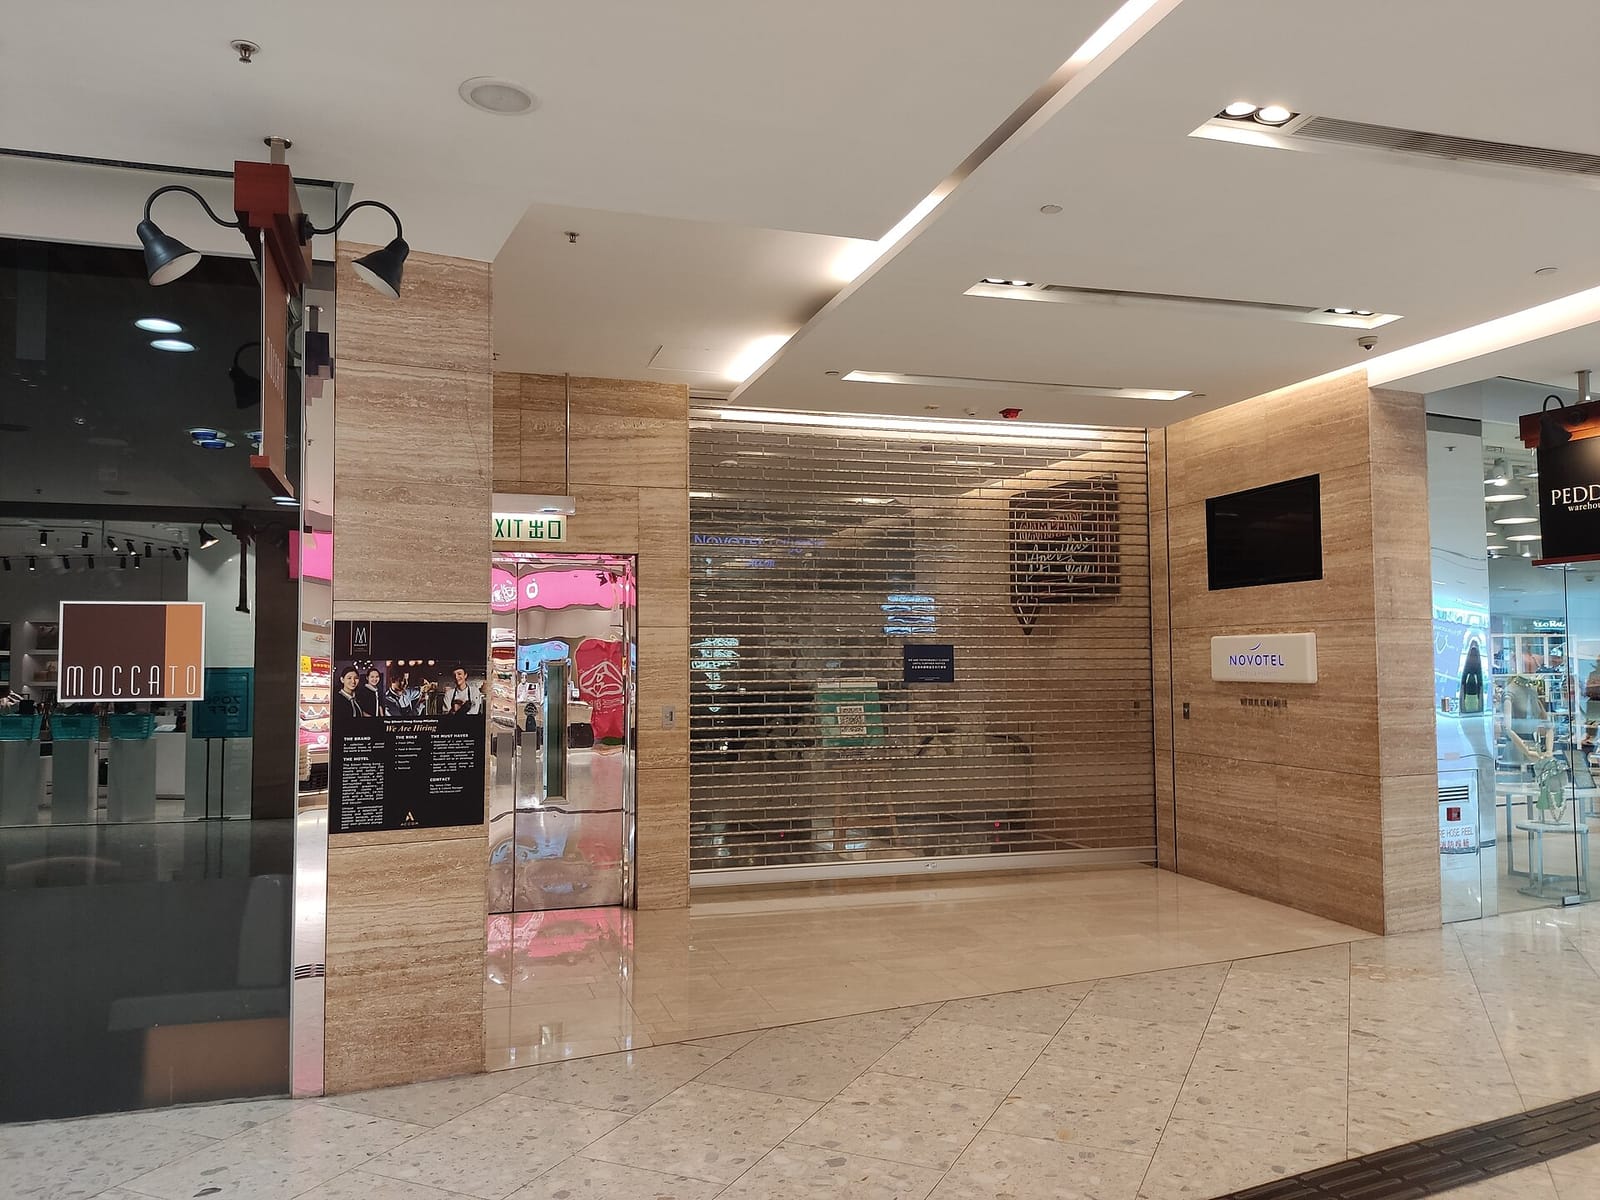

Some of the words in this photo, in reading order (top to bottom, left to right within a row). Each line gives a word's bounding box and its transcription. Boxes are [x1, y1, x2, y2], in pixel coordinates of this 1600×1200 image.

[528, 519, 562, 540] 出口
[1228, 654, 1285, 667] NOVOTEL
[66, 665, 196, 697] MOCCATO
[413, 724, 438, 733] Hiring
